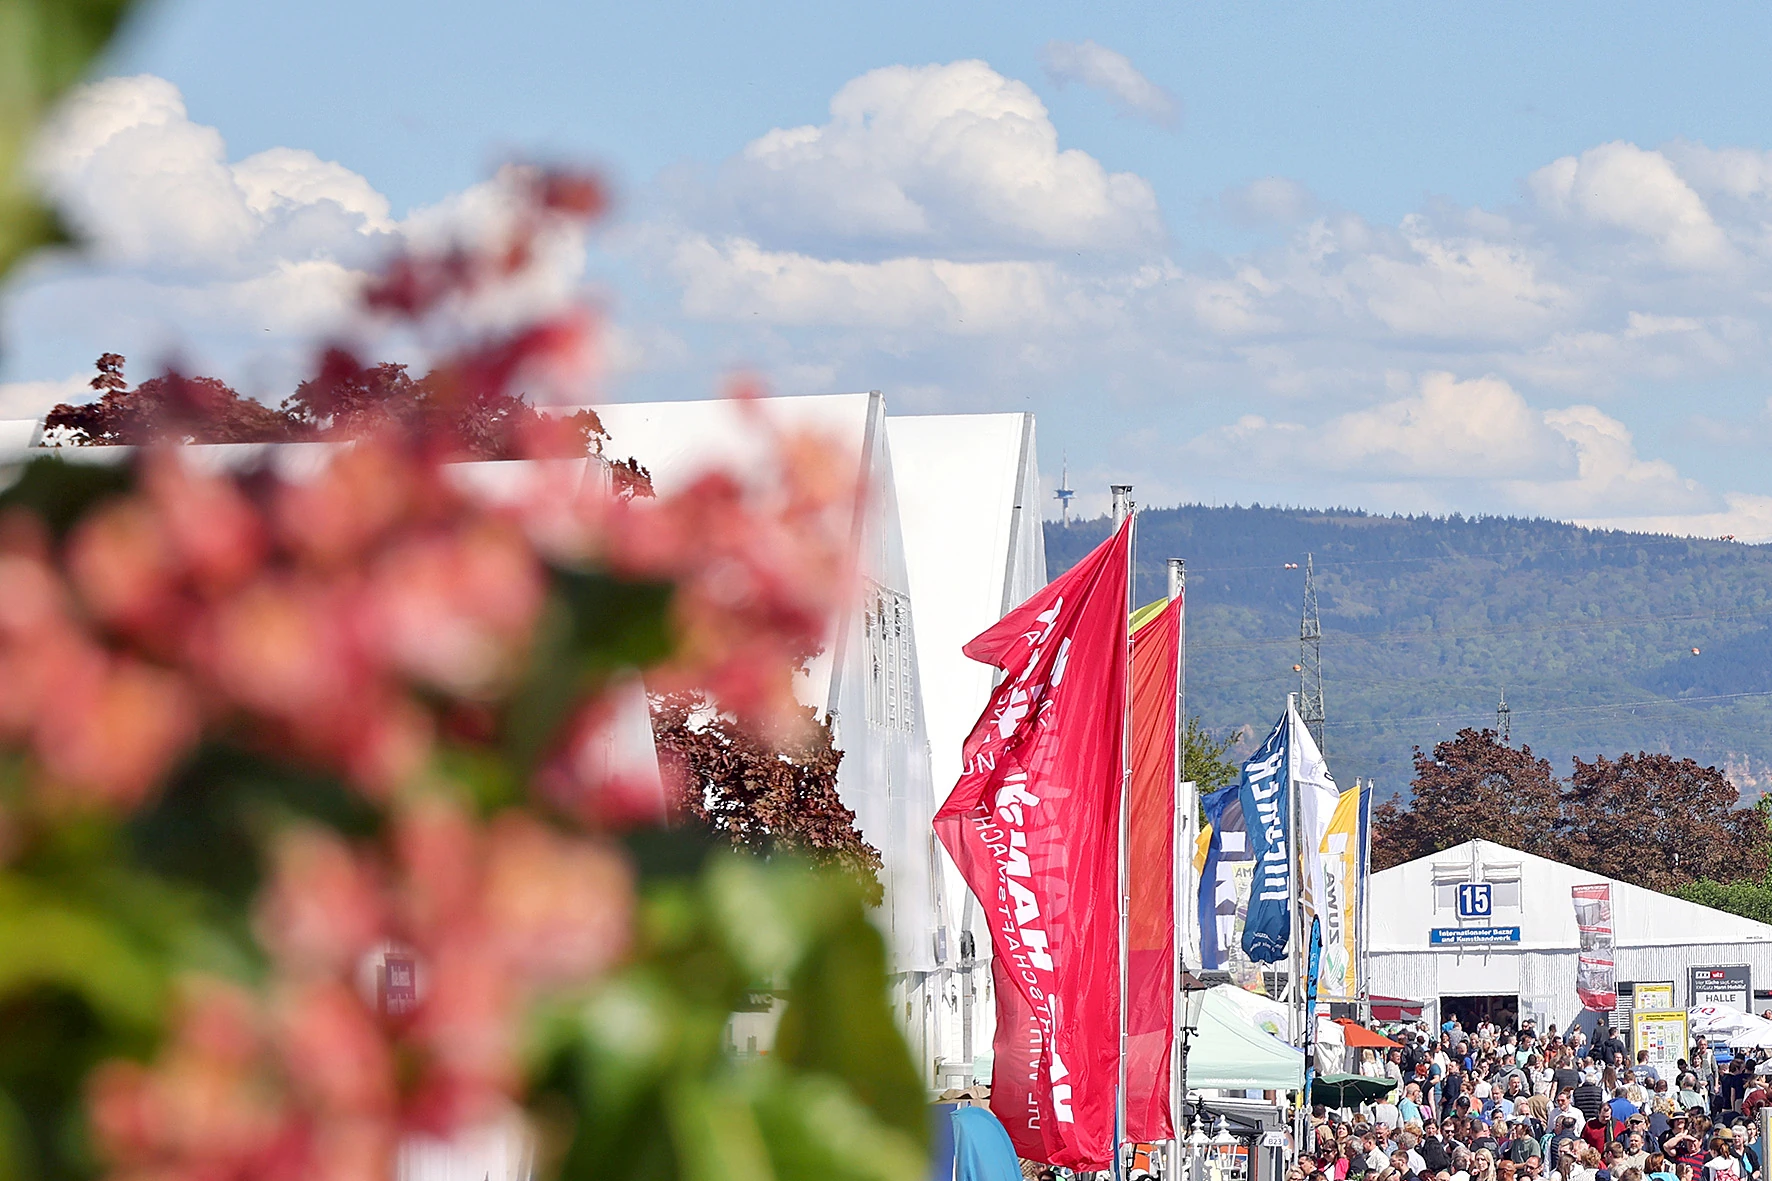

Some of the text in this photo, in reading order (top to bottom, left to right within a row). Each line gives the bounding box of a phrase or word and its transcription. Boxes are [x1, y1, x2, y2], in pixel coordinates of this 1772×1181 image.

[1462, 886, 1488, 914] 15
[1438, 929, 1492, 938] Internationaler
[1705, 994, 1736, 1003] HALLE
